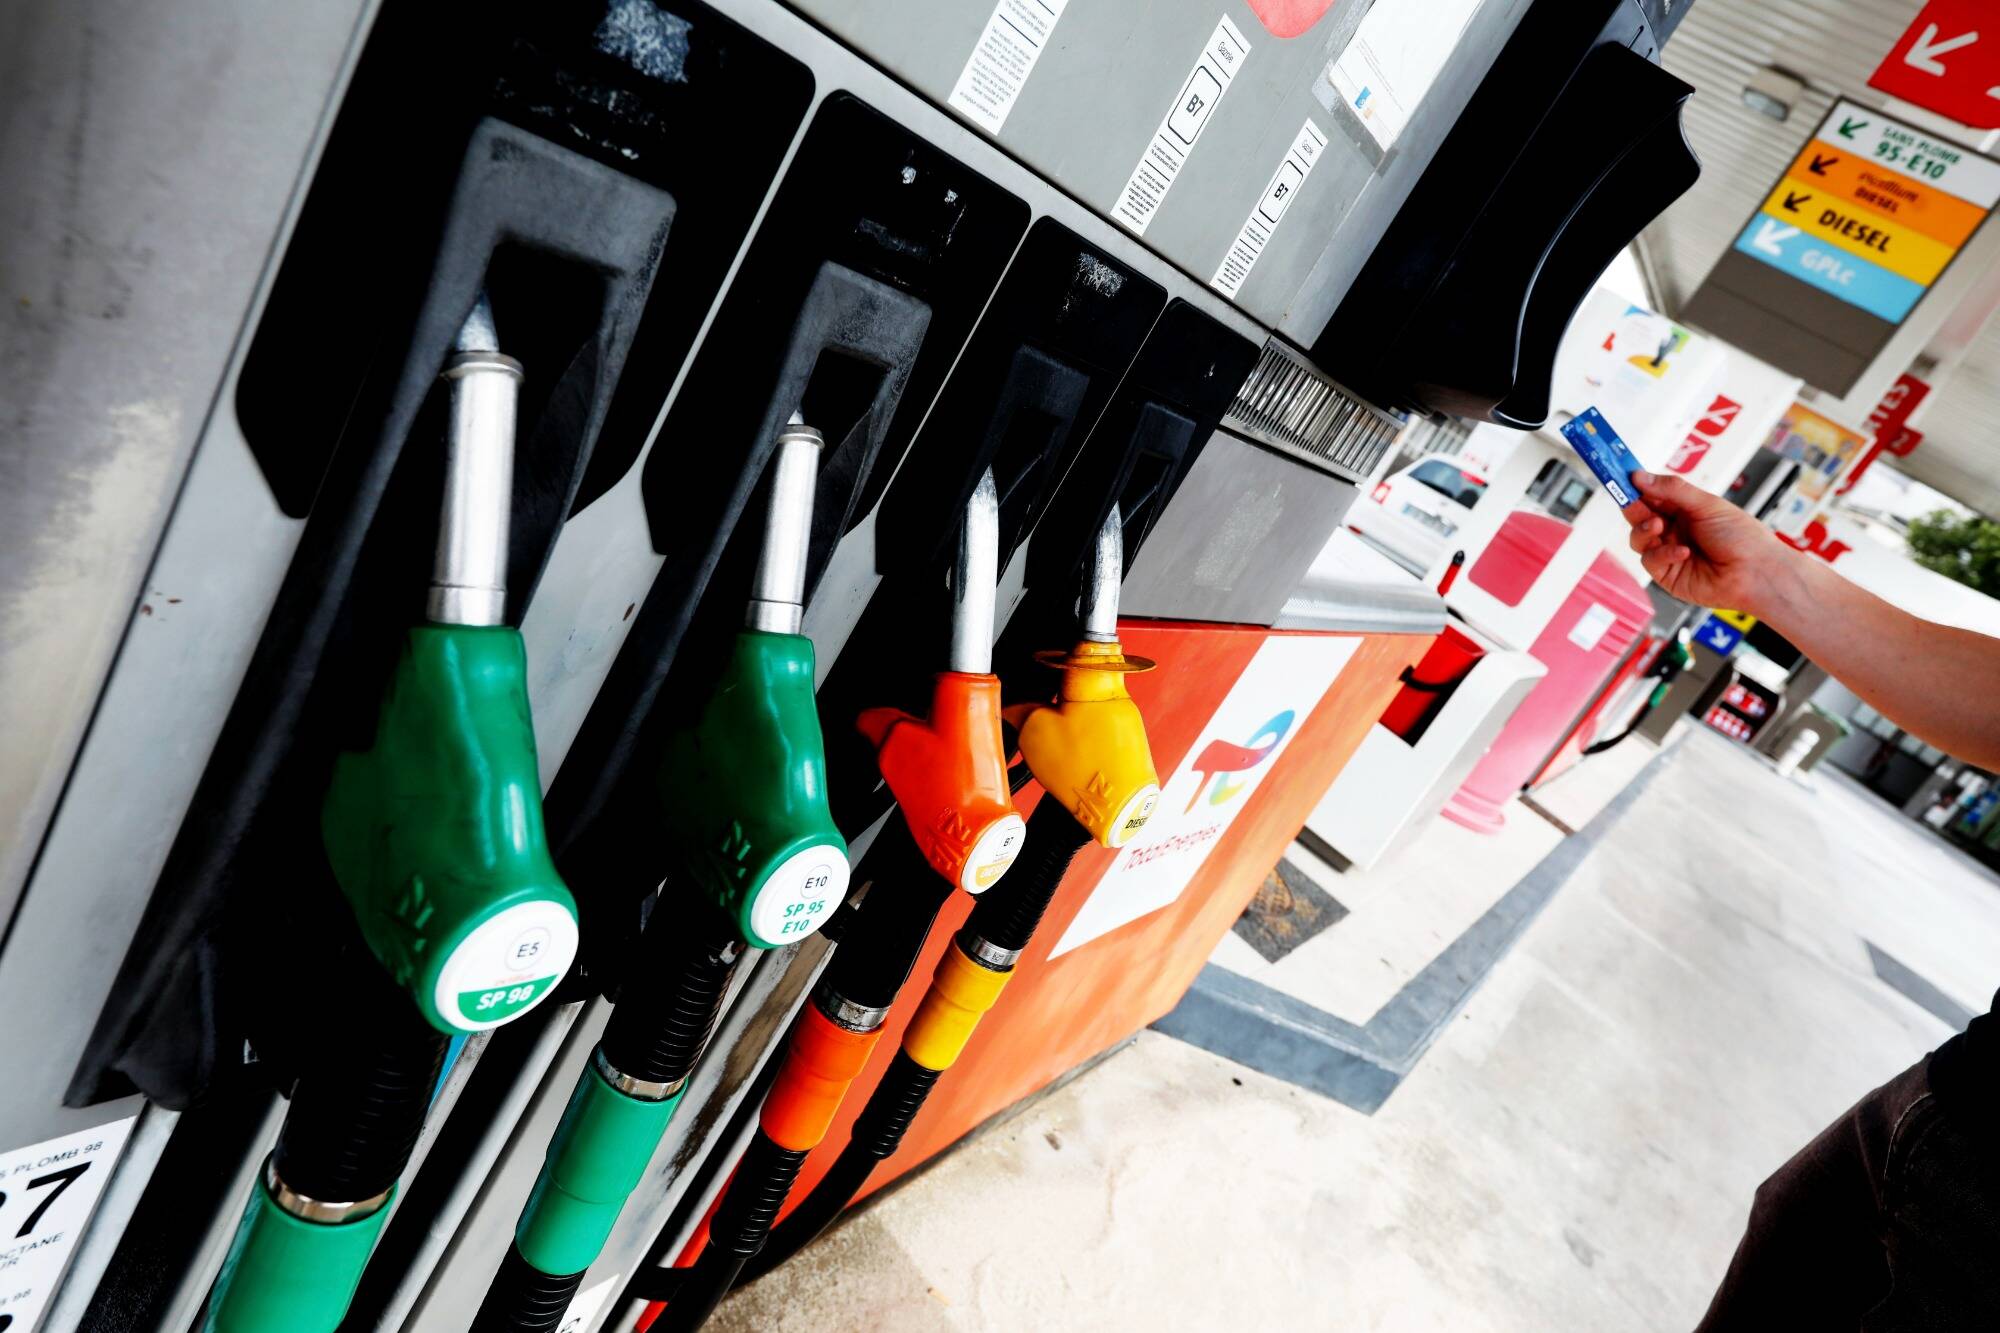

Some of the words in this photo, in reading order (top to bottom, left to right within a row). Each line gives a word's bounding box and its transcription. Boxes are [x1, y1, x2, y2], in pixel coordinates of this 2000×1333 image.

[1186, 93, 1204, 117] B7
[1274, 182, 1288, 201] B7
[1818, 208, 1891, 253] DIESEL
[804, 875, 828, 889] E10
[783, 904, 804, 918] SP
[806, 899, 825, 915] 95
[781, 918, 810, 935] E10
[516, 941, 540, 958] E5
[476, 991, 506, 1010] SP
[507, 984, 535, 1005] 98
[13, 1148, 79, 1175] PLOMB
[83, 1141, 103, 1154] 98
